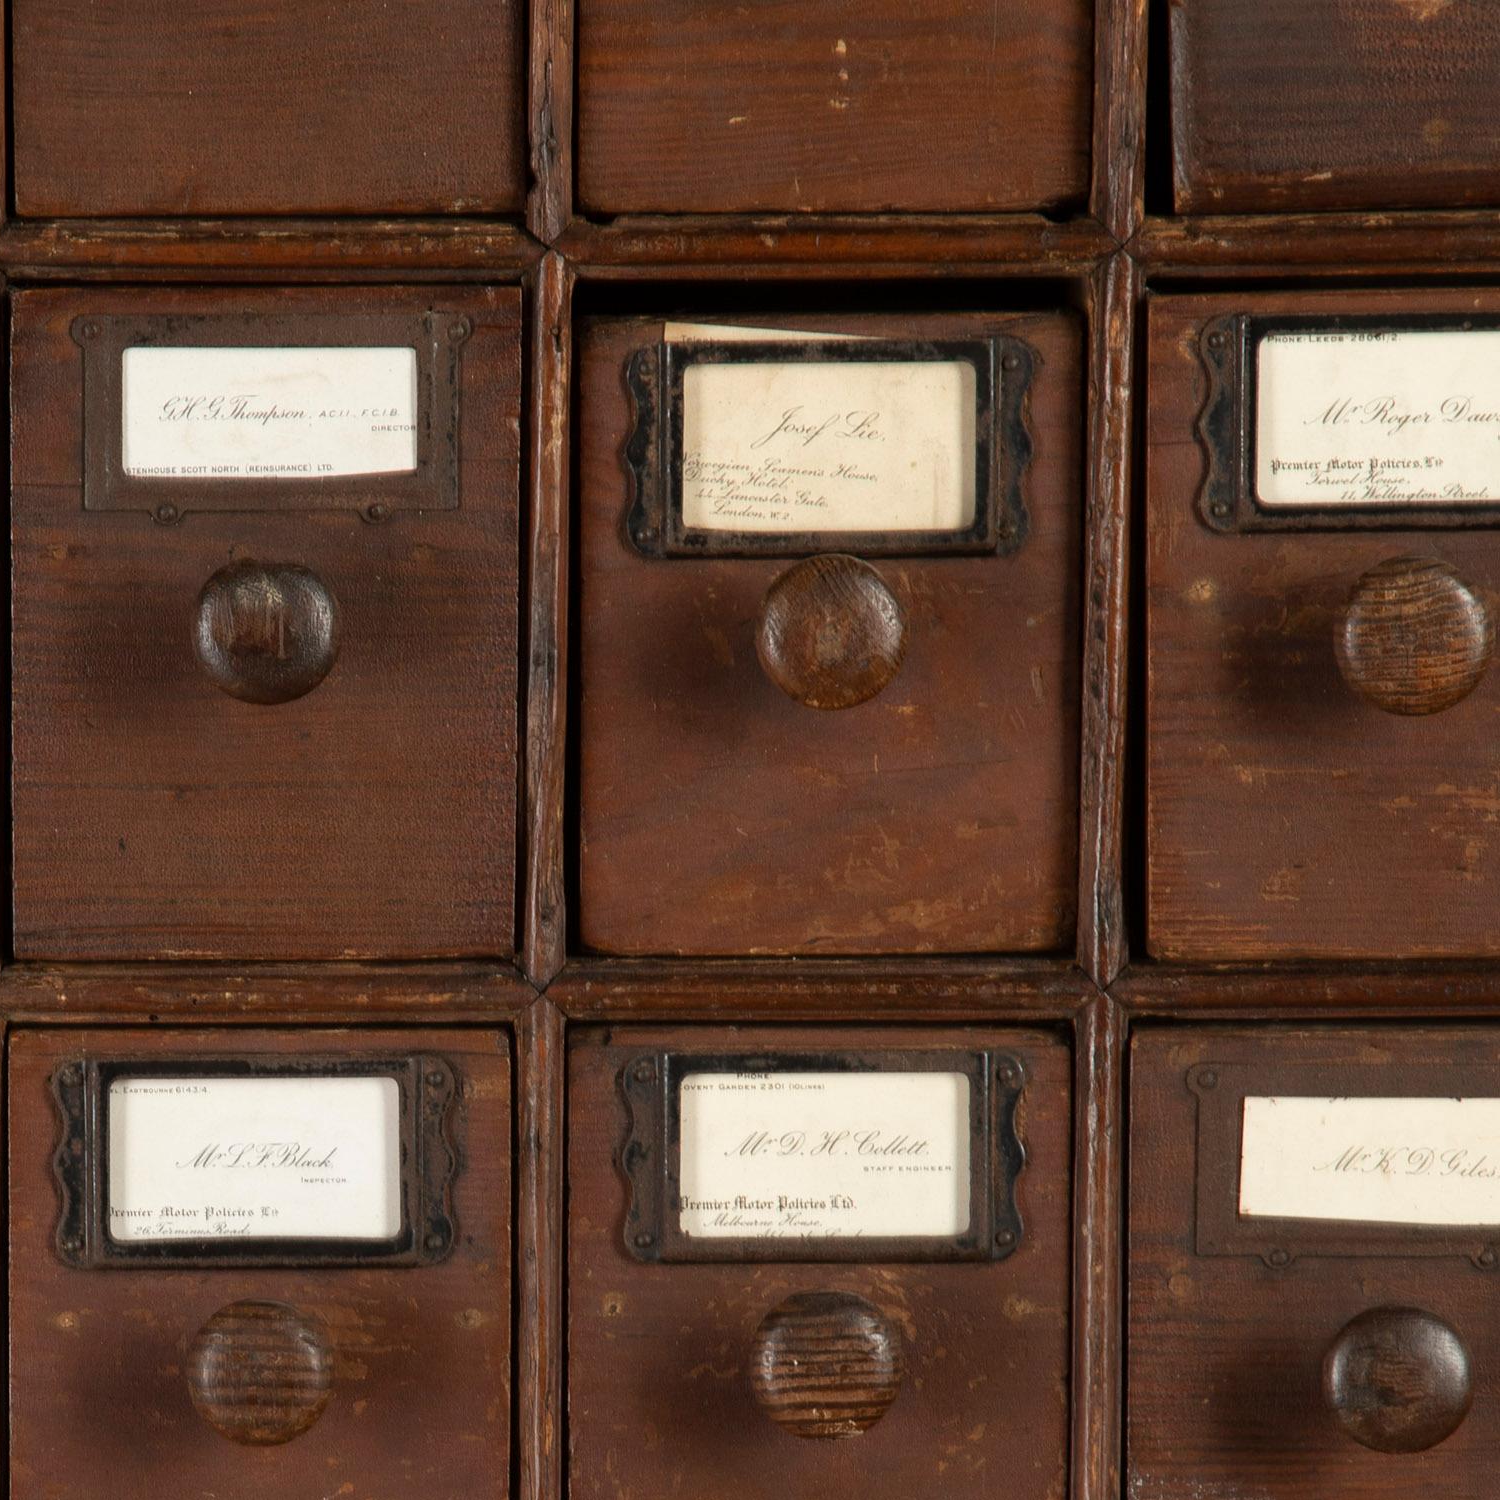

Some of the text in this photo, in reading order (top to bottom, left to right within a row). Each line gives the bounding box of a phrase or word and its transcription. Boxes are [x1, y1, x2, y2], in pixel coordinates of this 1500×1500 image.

[1309, 335, 1344, 343] LEEDS
[1360, 396, 1432, 436] Roger
[750, 405, 840, 449] Josef
[246, 463, 312, 474] (REINSURANCE)
[1271, 459, 1364, 475] Premier Motor
[1361, 486, 1437, 501] Wellington
[735, 1197, 773, 1210] Motor
[779, 1196, 826, 1212] Policies
[160, 1206, 198, 1217] Motor
[205, 1205, 254, 1220] Policies
